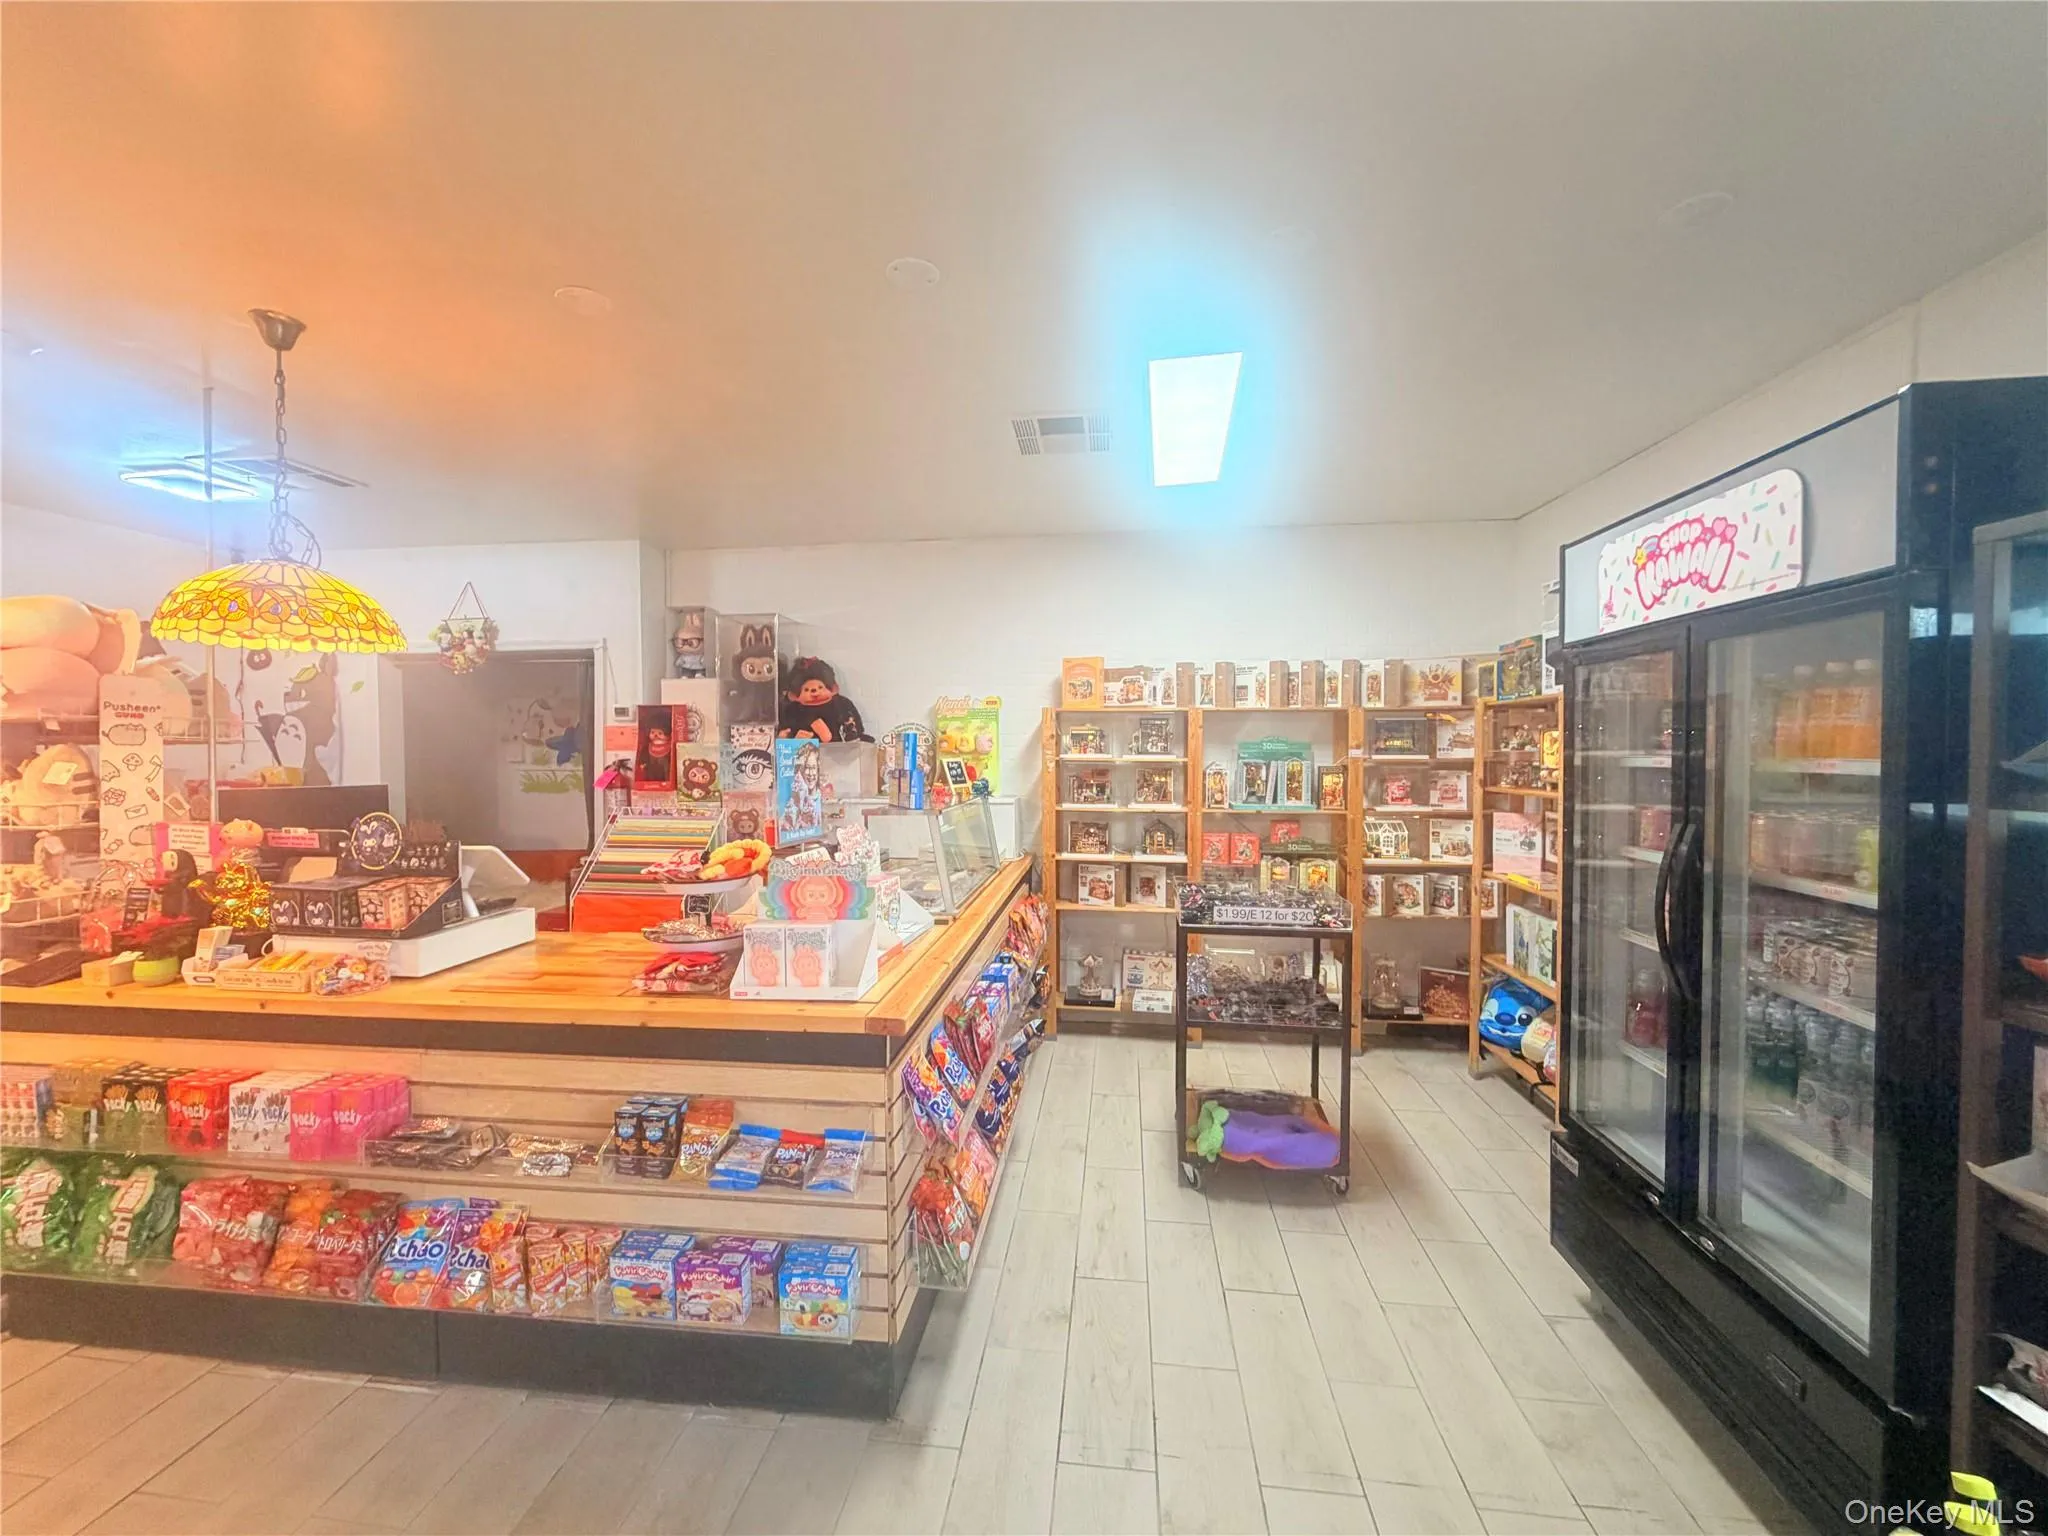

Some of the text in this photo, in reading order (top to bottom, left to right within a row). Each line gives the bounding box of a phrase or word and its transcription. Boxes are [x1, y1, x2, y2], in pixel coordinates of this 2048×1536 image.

[1659, 520, 1704, 554] SHOP
[1637, 537, 1734, 607] KAWAII
[103, 700, 156, 713] Pusheen
[1216, 908, 1313, 922] $1.99/E 12 for $20
[681, 1142, 714, 1157] PANDA
[774, 1147, 807, 1160] PANDA
